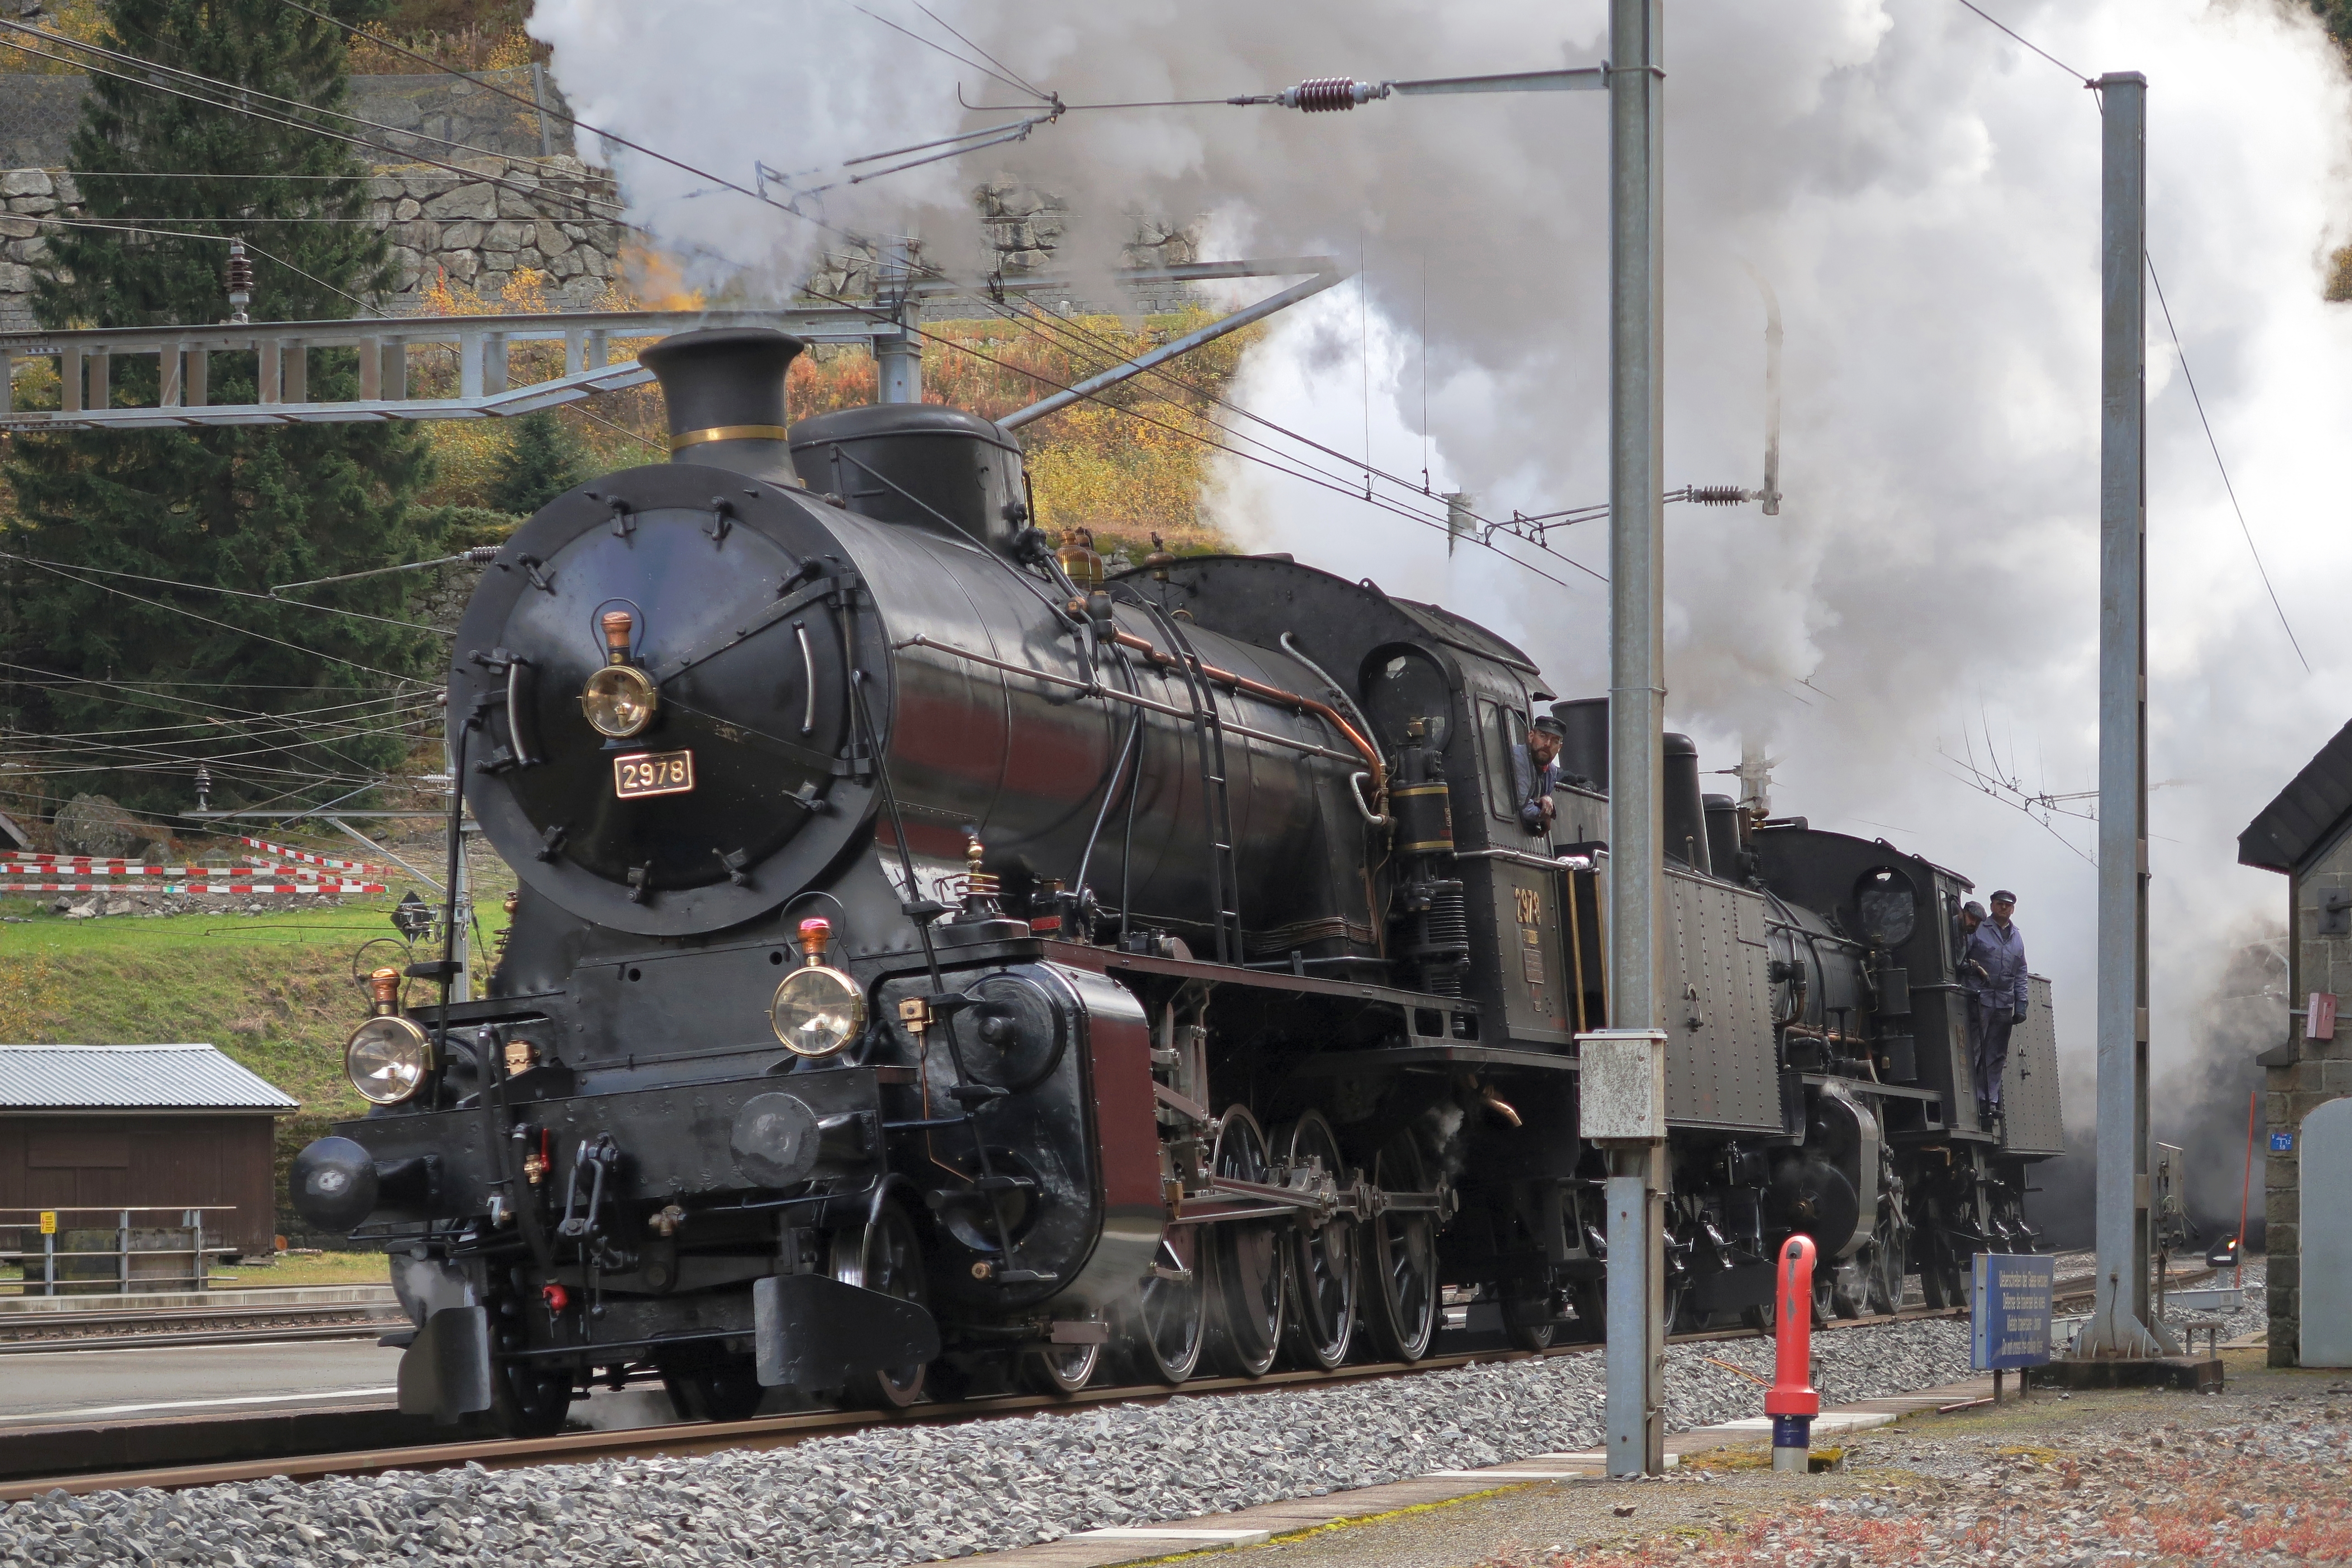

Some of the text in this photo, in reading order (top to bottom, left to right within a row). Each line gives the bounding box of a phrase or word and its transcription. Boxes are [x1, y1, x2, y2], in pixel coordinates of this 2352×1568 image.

[622, 759, 683, 789] 2978
[1514, 888, 1541, 926] 2978
[1999, 1270, 2021, 1288] Ueberschreiten
[2003, 1292, 2015, 1310] Défense
[2016, 1293, 2020, 1309] de
[2021, 1293, 2033, 1309] traverser
[2002, 1338, 2007, 1355] Do
[2013, 1341, 2021, 1355] cross
